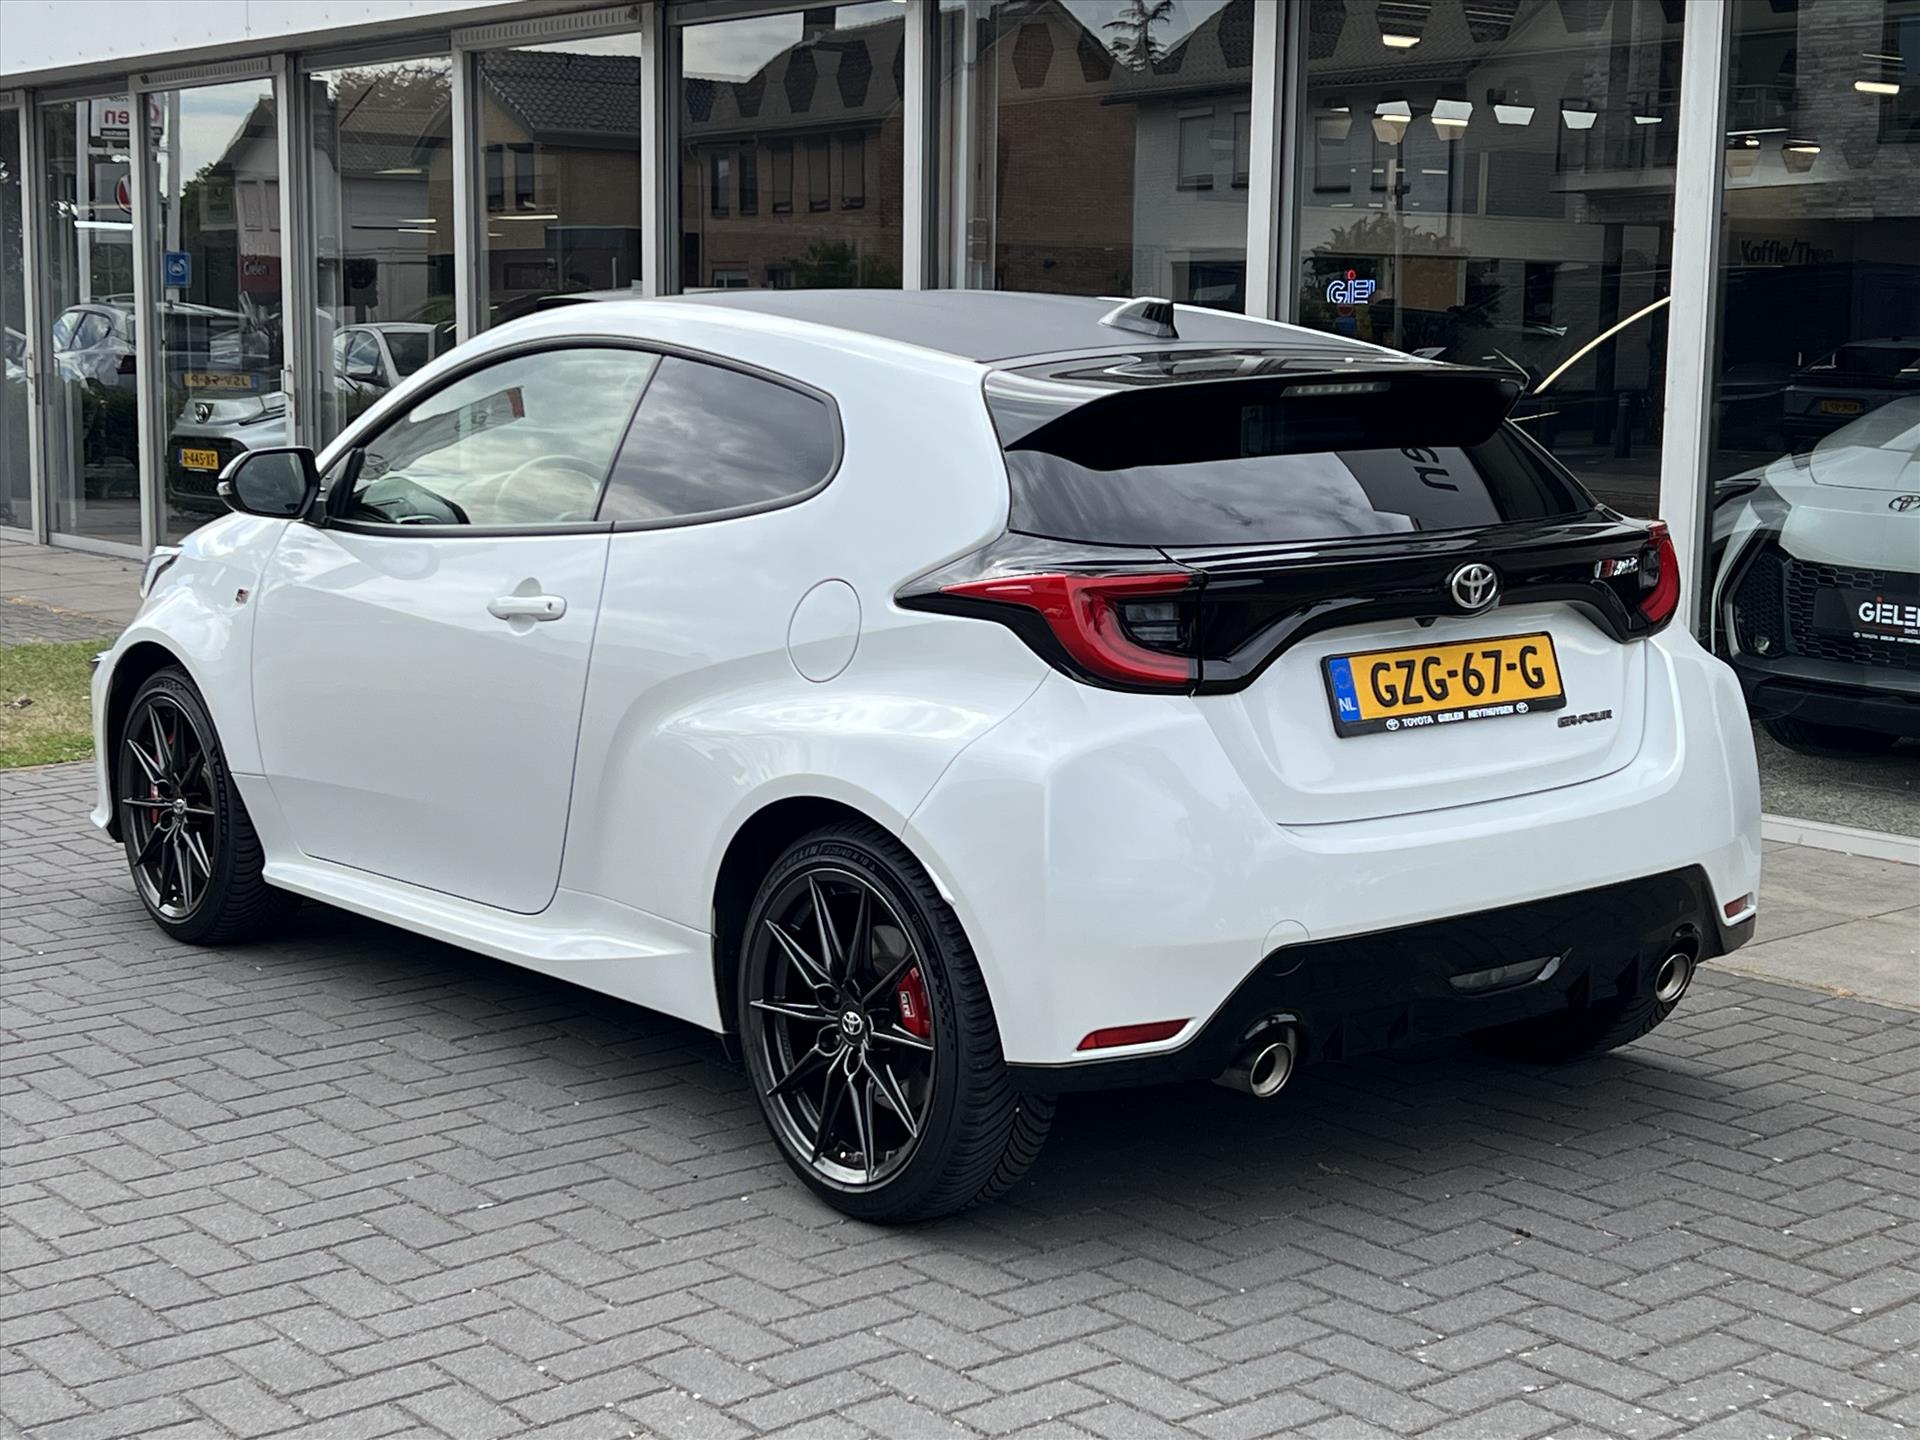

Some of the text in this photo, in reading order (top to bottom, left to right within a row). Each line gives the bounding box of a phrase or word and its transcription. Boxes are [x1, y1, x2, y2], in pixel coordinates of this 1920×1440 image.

[1858, 596, 1920, 627] GIELE
[1370, 645, 1545, 708] GZG-67-G
[1339, 698, 1357, 712] NL
[1401, 715, 1434, 727] TOYOTA
